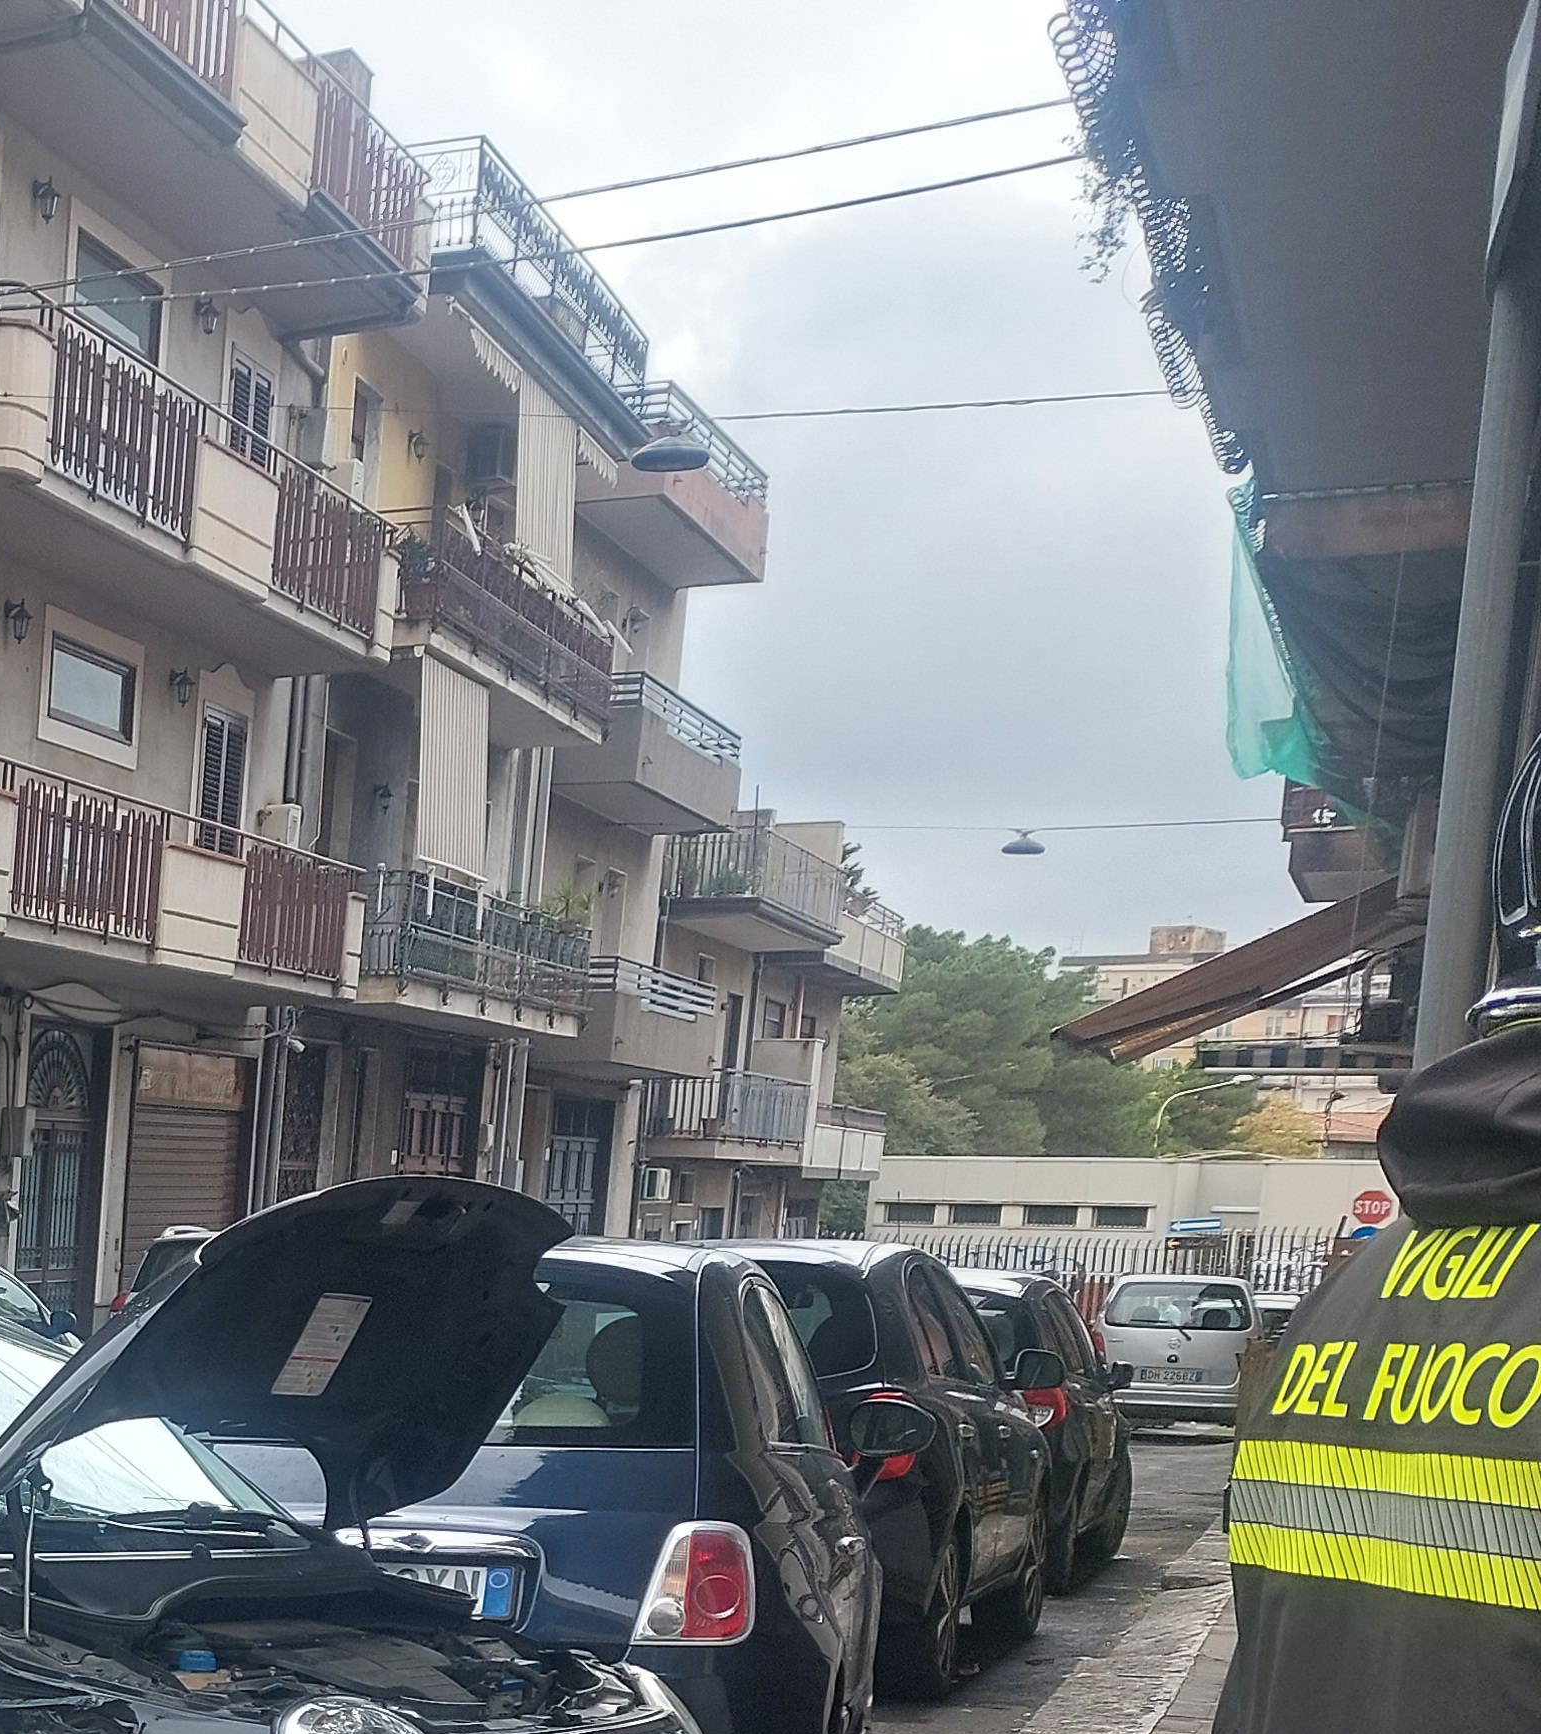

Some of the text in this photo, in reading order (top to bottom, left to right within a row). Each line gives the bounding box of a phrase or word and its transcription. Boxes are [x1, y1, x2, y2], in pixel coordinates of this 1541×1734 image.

[1354, 1200, 1391, 1215] STOP
[1381, 1223, 1540, 1301] VIGILI
[1271, 1340, 1541, 1428] DEL FUOCO
